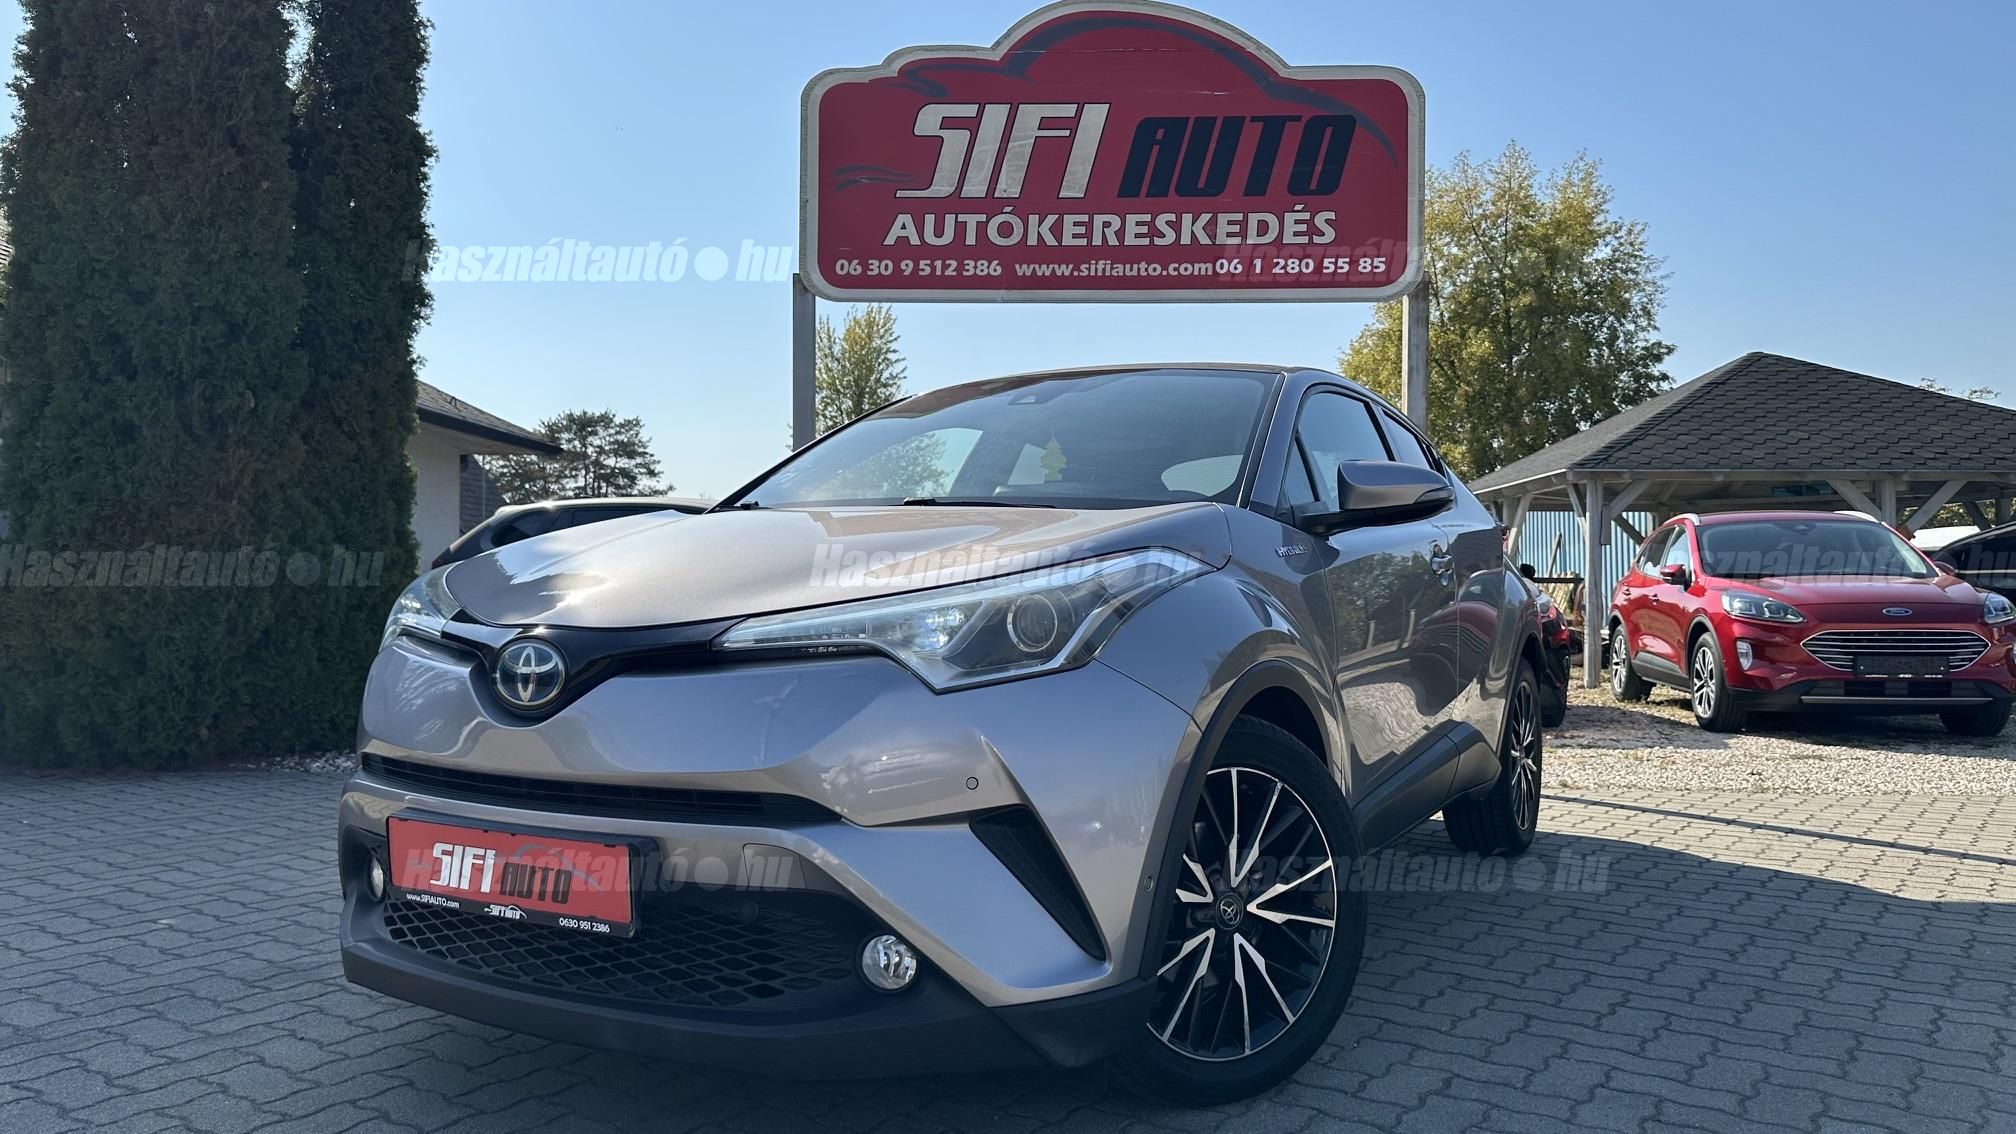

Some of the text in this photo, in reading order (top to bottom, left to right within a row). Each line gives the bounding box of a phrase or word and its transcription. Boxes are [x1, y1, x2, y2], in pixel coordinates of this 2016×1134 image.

[895, 103, 1358, 199] SIFI AUTO
[882, 205, 1338, 247] AUTÓKERESKEDÉS
[835, 259, 1002, 276] 06 30 9 512 386
[1015, 259, 1213, 277] www.sifiauto.com
[1215, 257, 1386, 275] 06 1 280 55 85
[430, 842, 572, 905] SIFI AUTO
